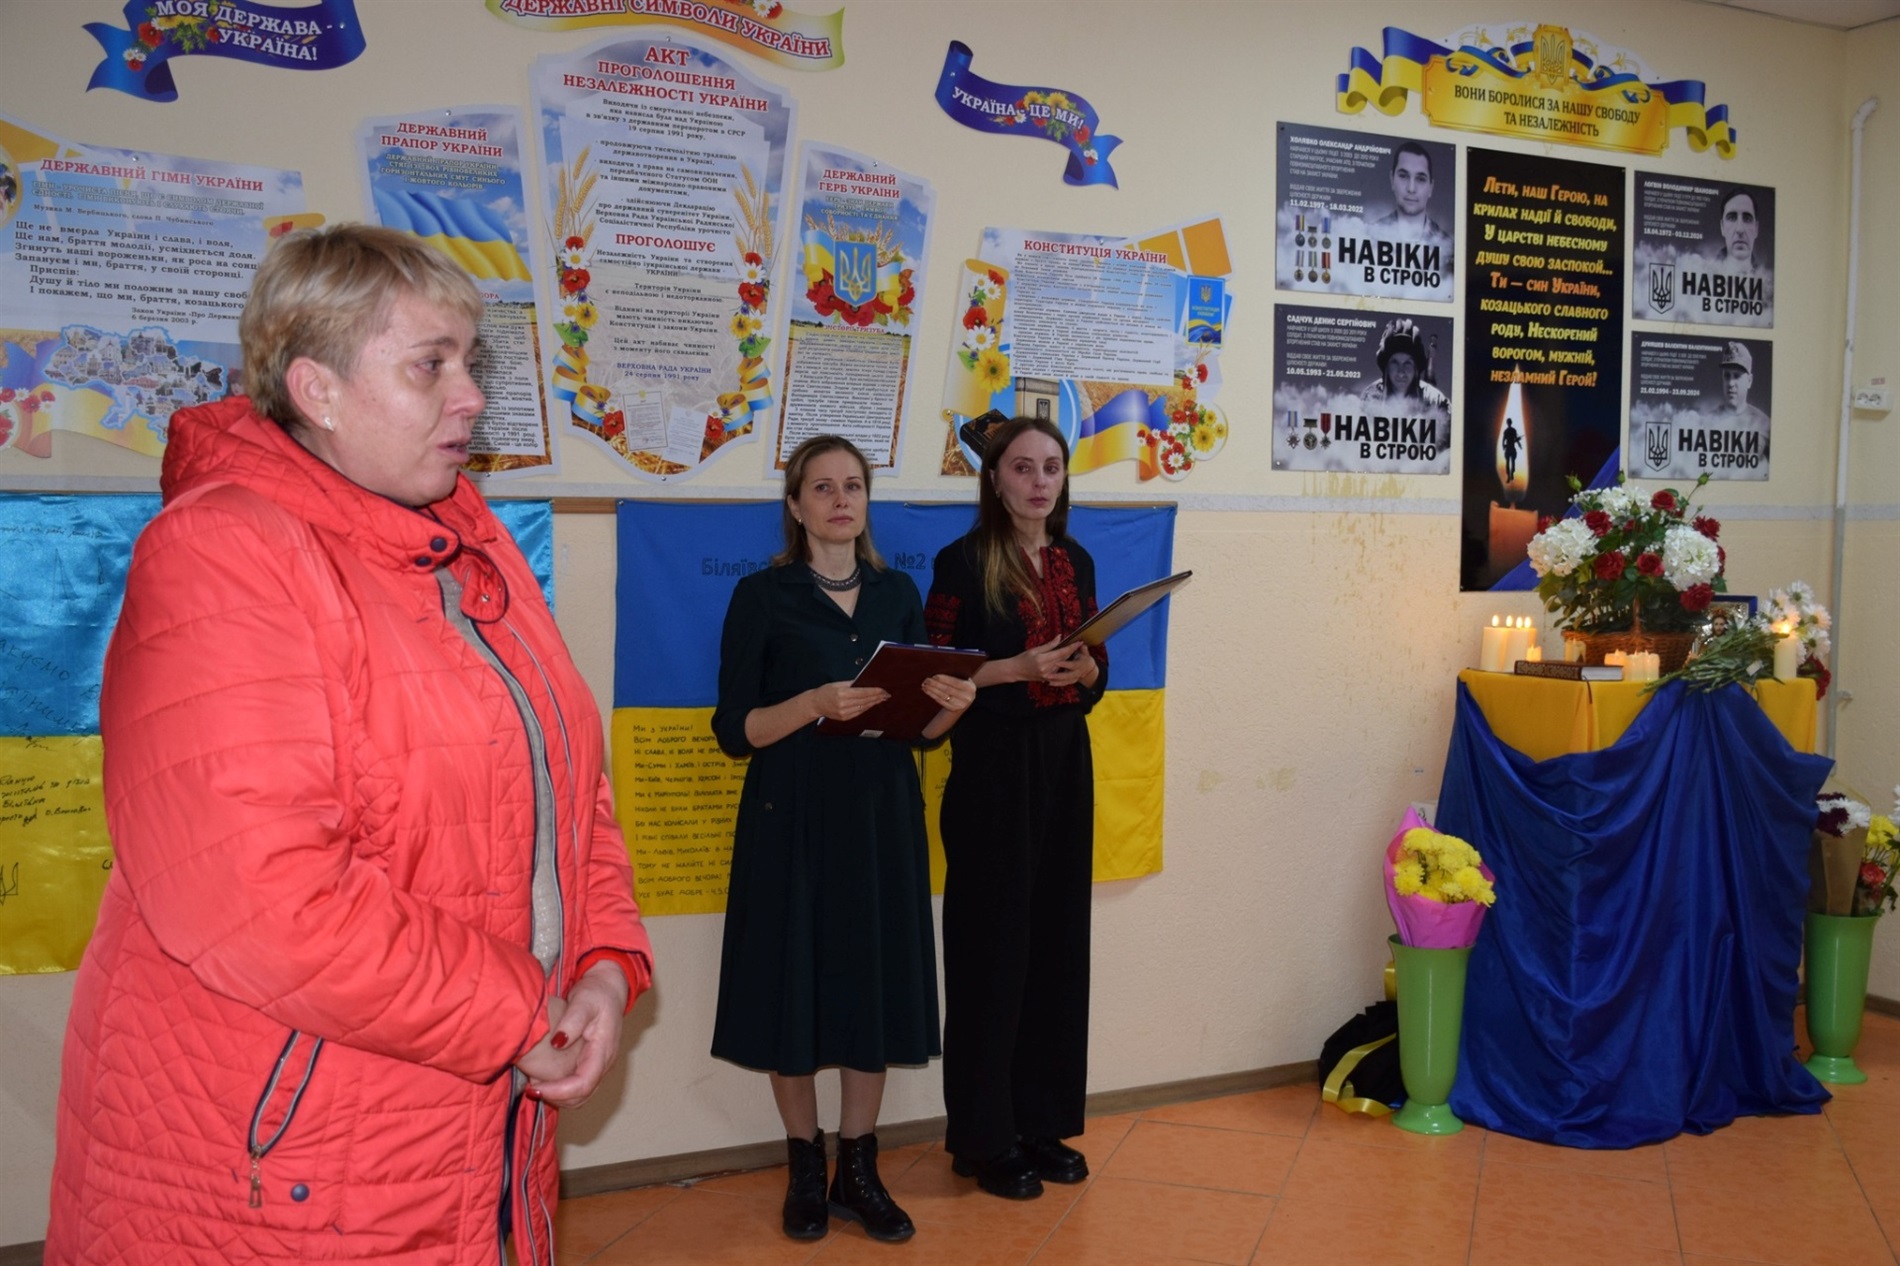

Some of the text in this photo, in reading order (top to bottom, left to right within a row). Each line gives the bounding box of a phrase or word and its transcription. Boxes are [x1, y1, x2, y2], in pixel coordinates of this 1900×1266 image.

[155, 0, 209, 18] МОЯ
[216, 6, 322, 35] ДЕРЖАВА
[502, 0, 831, 57] ДЕРЖАВНІ СИМВОЛИ УКРАЇНИ
[218, 28, 318, 61] УКРАЇНА!
[646, 47, 689, 66] АКТ
[599, 61, 735, 90] ПРОГОЛОШЕННЯ
[563, 74, 768, 112] НЕЗАЛЕЖНОСТІ УКРАЇНИ
[1454, 84, 1640, 125] ВОНИ БОРОЛИСЯ ЗА НАШУ СВОБОДУ
[952, 86, 1016, 116] УКРАЇНА
[1030, 104, 1050, 119] ЦЕ
[1055, 107, 1084, 129] МИ!
[397, 122, 487, 141] ДЕРЖАВНИЙ
[1504, 112, 1599, 137] ТА НЕЗАЛЕЖНІСТЬ
[381, 136, 502, 157] ПРАПОР УКРАЇНИ
[40, 159, 263, 191] ДЕРЖАВНИЙ ГІМН УКРАЇНИ
[823, 169, 896, 185] ДЕРЖАВНИЙ
[819, 182, 900, 198] ГЕРБ УКРАЇНИ
[16, 221, 34, 230] Ще
[60, 226, 99, 236] вмерла
[107, 229, 151, 240] України
[162, 235, 195, 245] слава,
[206, 240, 234, 248] воля,
[616, 233, 715, 252] ПРОГОЛОШУЄ
[1484, 224, 1496, 241] У
[15, 231, 256, 260] Ще нам, браття молодії, усміхнеться доля.
[15, 242, 62, 254] Згинуть
[66, 247, 93, 256] наші
[98, 250, 168, 263] вороженьки,
[189, 258, 212, 266] роса
[1024, 240, 1168, 264] КОНСТИТУЦІЯ УКРАЇНИ
[1338, 237, 1440, 271] НАВІКИ
[15, 253, 70, 265] Запануєм
[83, 260, 102, 268] ми,
[106, 260, 147, 272] браття,
[161, 266, 190, 274] своїй
[194, 268, 244, 279] сторонці.
[30, 264, 80, 276] Приспів:
[1364, 267, 1440, 288] В СТРОЮ
[29, 275, 62, 286] Душу
[66, 278, 73, 286] й
[77, 280, 100, 288] тіло
[124, 283, 173, 294] положим
[192, 289, 220, 299] нашу
[38, 287, 93, 299] покажем,
[97, 292, 113, 300] що
[117, 294, 136, 302] ми,
[140, 294, 181, 305] браття,
[185, 299, 245, 309] козацького
[1682, 272, 1763, 300] НАВІКИ
[1702, 298, 1763, 315] В СТРОЮ
[1287, 315, 1376, 328] САДЧУК ДЕНИС СЕРГІЙОВИЧ
[1335, 415, 1436, 444] НАВІКИ
[1679, 429, 1759, 453] НАВІКИ
[1360, 443, 1436, 461] В СТРОЮ
[1699, 454, 1759, 468] В СТРОЮ
